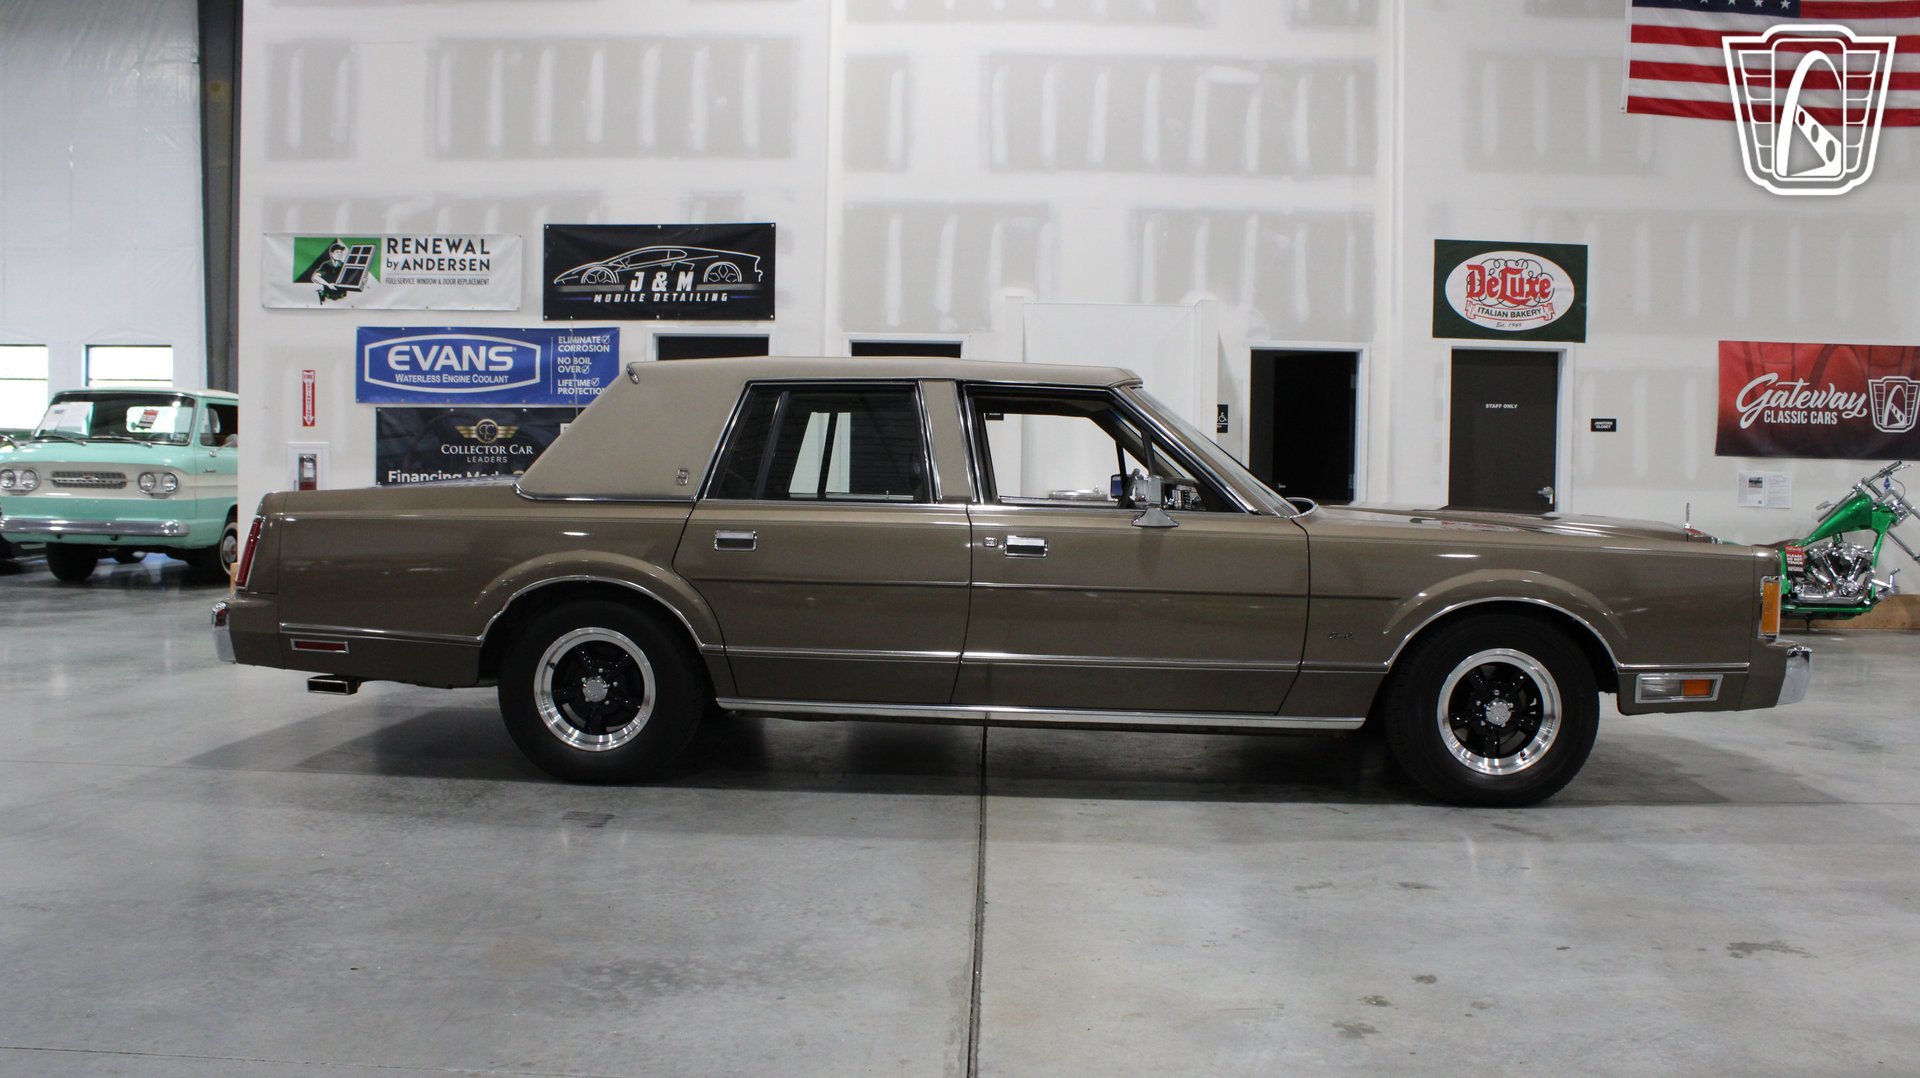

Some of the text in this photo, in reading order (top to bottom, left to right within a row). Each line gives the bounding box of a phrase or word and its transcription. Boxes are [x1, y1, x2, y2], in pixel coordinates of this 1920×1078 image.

[387, 238, 490, 254] RENEWAL
[386, 258, 489, 271] by ANDERSEN
[416, 277, 437, 285] WINDOW
[457, 278, 489, 286] REPLACEMENT
[629, 271, 694, 292] J & M
[1466, 264, 1552, 305] DeLuxe
[593, 292, 728, 303] MOBILE DETAILING
[1477, 306, 1542, 318] ITALIAN BAKERY
[558, 336, 601, 344] ELIMINATE
[558, 344, 610, 353] CORROSION
[387, 345, 514, 371] EVANS
[557, 356, 592, 365] NO BOIL
[557, 366, 581, 374] OVER
[395, 373, 509, 383] WATERLESS ENGINE COOLANT
[557, 379, 591, 387] LIFETIME
[1735, 372, 1868, 429] Gateway
[1763, 410, 1838, 425] CLASSIC CARS
[441, 443, 534, 455] COLLECTOR CAR
